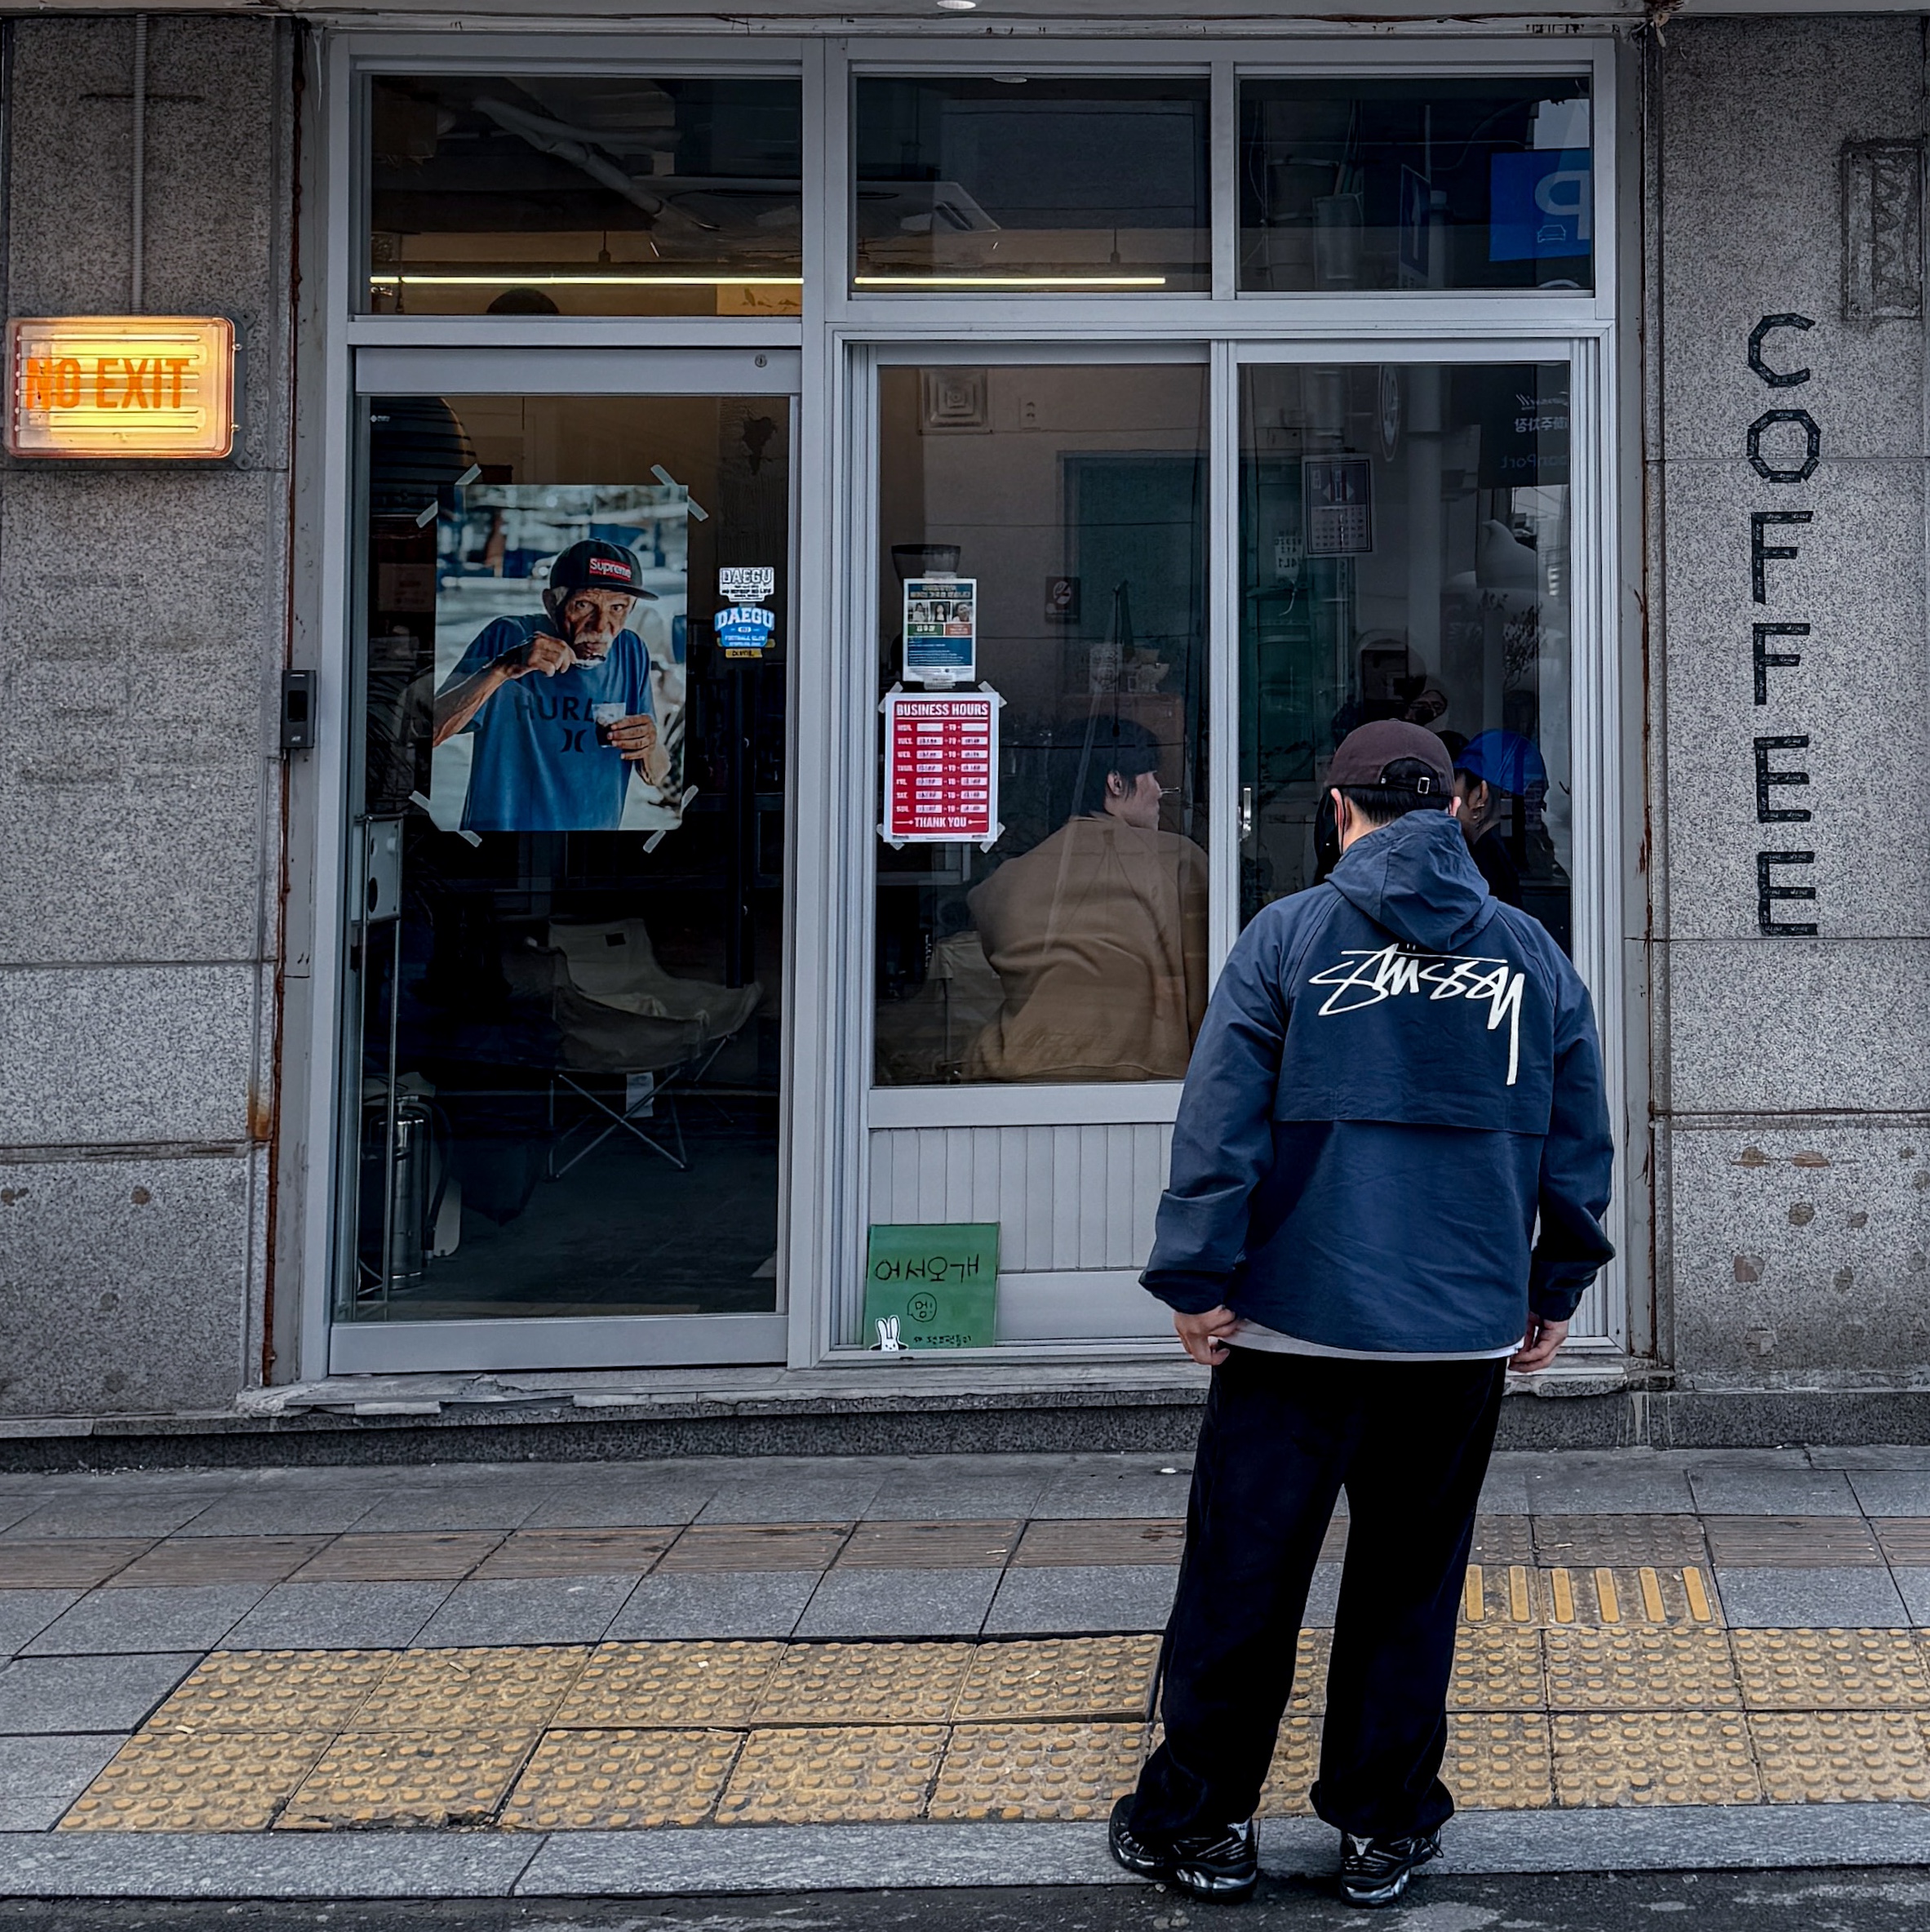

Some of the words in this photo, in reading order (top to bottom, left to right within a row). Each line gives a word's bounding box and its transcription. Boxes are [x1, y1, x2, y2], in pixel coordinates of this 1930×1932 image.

[26, 357, 81, 410] NO
[95, 358, 190, 409] EXIT
[589, 557, 632, 579] Supreme
[722, 569, 771, 584] DAEGU
[717, 606, 773, 629] DAEGU
[1747, 313, 1821, 935] COFFEE
[514, 695, 610, 723] HURL
[896, 703, 950, 717] BUSINESS
[952, 703, 988, 716] HOURS
[915, 817, 947, 828] THANK
[947, 816, 967, 828] YOU
